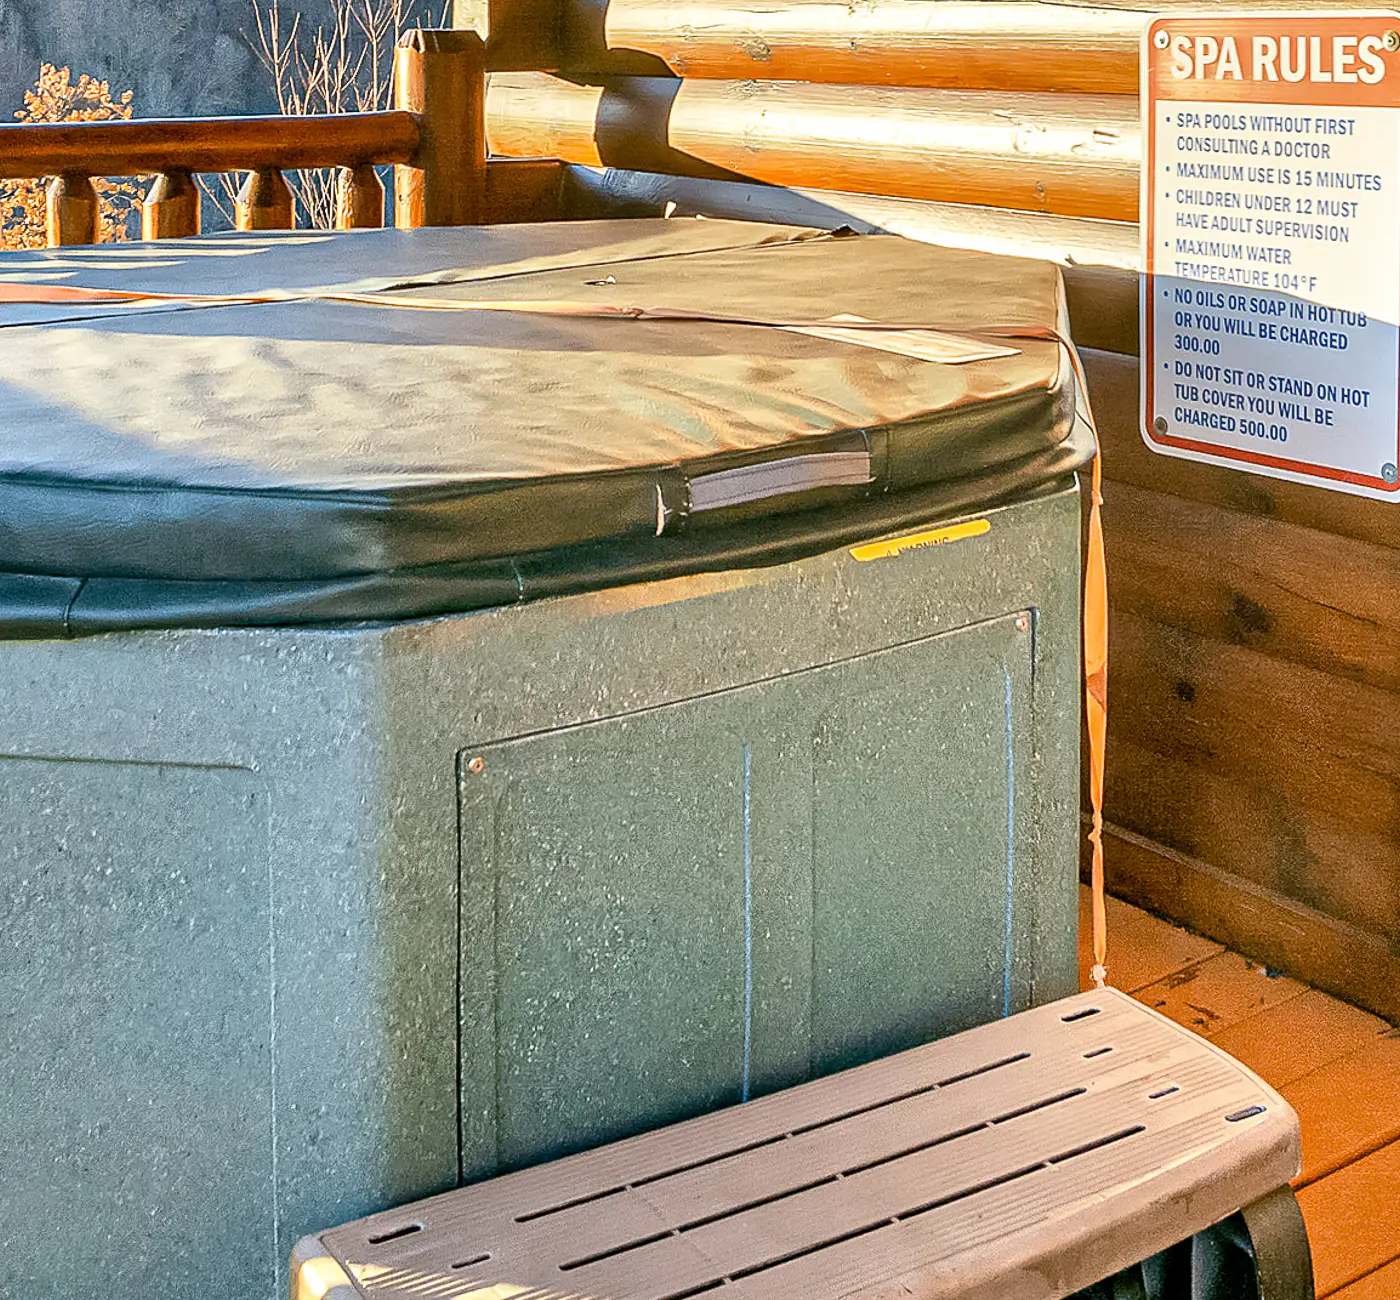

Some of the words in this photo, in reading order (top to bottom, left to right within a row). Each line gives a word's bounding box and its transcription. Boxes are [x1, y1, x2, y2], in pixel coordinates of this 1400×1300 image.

[1171, 36, 1243, 81] SPA
[1252, 36, 1385, 84] RULES
[1176, 113, 1201, 128] SPA
[1204, 115, 1246, 131] POOLS
[1250, 116, 1311, 133] WITHOUT
[1315, 119, 1355, 135] FIRST
[1176, 136, 1258, 155] CONSULTING
[1262, 141, 1271, 156] A
[1275, 141, 1330, 159] DOCTOR
[1176, 162, 1243, 182] MAXIMUM
[1248, 167, 1274, 183] USE
[1278, 170, 1290, 185] IS
[1296, 171, 1312, 186] 15
[1316, 172, 1381, 191] MINUTES
[1176, 189, 1240, 208] CHILDREN
[1245, 194, 1291, 213] UNDER
[1296, 199, 1312, 214] 12
[1317, 200, 1358, 218] MUST
[1176, 213, 1209, 229] HAVE
[1212, 215, 1252, 233] ADULT
[1256, 219, 1349, 242] SUPERVISION
[1176, 239, 1243, 259] MAXIMUM
[1247, 246, 1291, 264] WATER
[1175, 262, 1269, 286] TEMPERATURE
[1175, 288, 1192, 304] NO
[1196, 291, 1224, 308] OILS
[1229, 296, 1246, 310] OR
[1250, 298, 1286, 316] SOAP
[1290, 303, 1303, 319] IN
[1308, 305, 1335, 323] HOT
[1337, 309, 1367, 327] TUB
[1175, 312, 1192, 328] OR
[1195, 314, 1220, 332] YOU
[1224, 318, 1255, 337] WILL
[1259, 323, 1276, 339] BE
[1280, 326, 1348, 350] CHARGED
[1175, 335, 1220, 355] 300.00
[1175, 361, 1191, 377] DO
[1196, 364, 1220, 382] NOT
[1224, 368, 1243, 385] SIT
[1247, 373, 1264, 389] OR
[1269, 376, 1313, 397] STAND
[1317, 384, 1337, 401] ON
[1341, 388, 1370, 407] HOT
[1174, 383, 1198, 401] TUB
[1202, 388, 1244, 409] COVER
[1247, 396, 1274, 415] YOU
[1279, 402, 1311, 423] WILL
[1315, 409, 1333, 426] BE
[1175, 407, 1235, 432] CHARGED
[1240, 419, 1287, 442] 500.00
